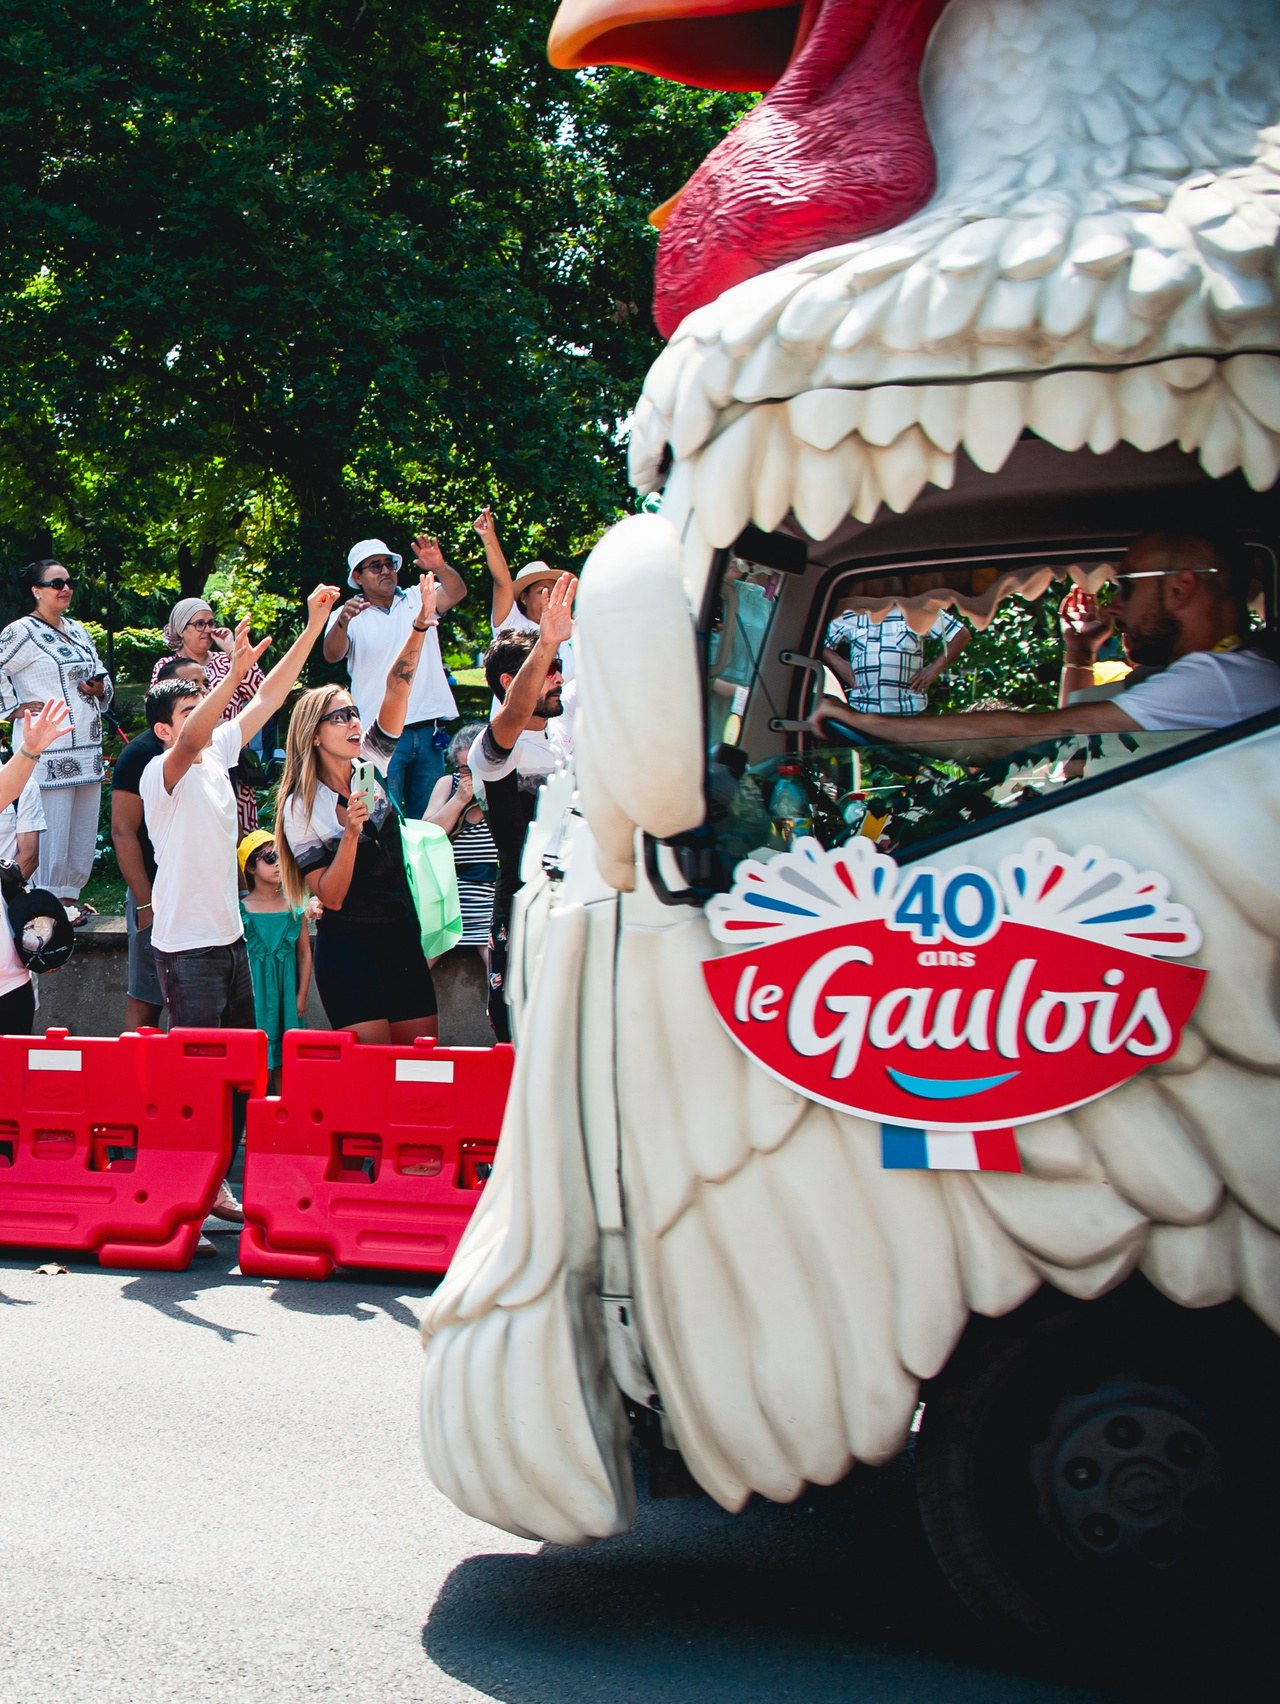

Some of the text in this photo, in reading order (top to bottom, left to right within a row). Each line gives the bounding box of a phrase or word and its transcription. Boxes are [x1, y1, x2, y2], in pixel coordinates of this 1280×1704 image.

[895, 872, 996, 939] 40
[917, 950, 977, 968] ans
[734, 945, 1173, 1079] le Gaulois
